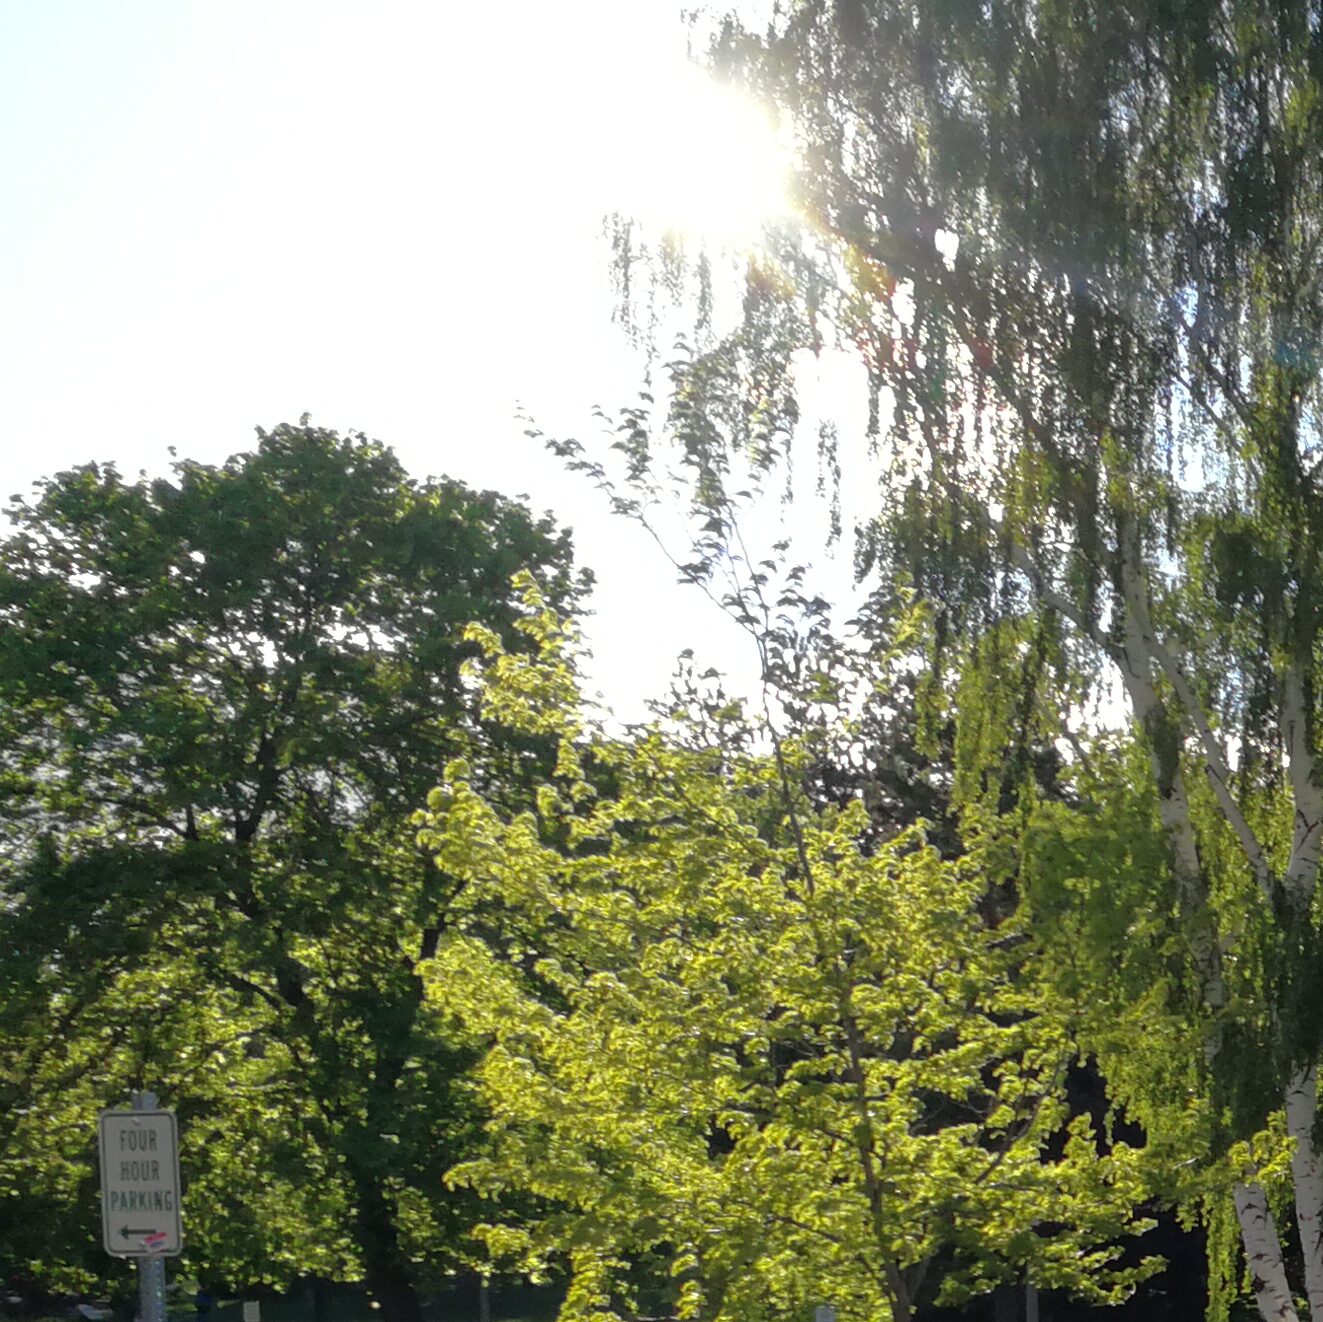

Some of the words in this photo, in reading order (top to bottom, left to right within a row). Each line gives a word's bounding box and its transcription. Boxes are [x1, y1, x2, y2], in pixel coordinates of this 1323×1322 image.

[120, 1130, 158, 1151] FOUR
[120, 1160, 160, 1181] HOUR
[111, 1191, 172, 1211] PARKING
